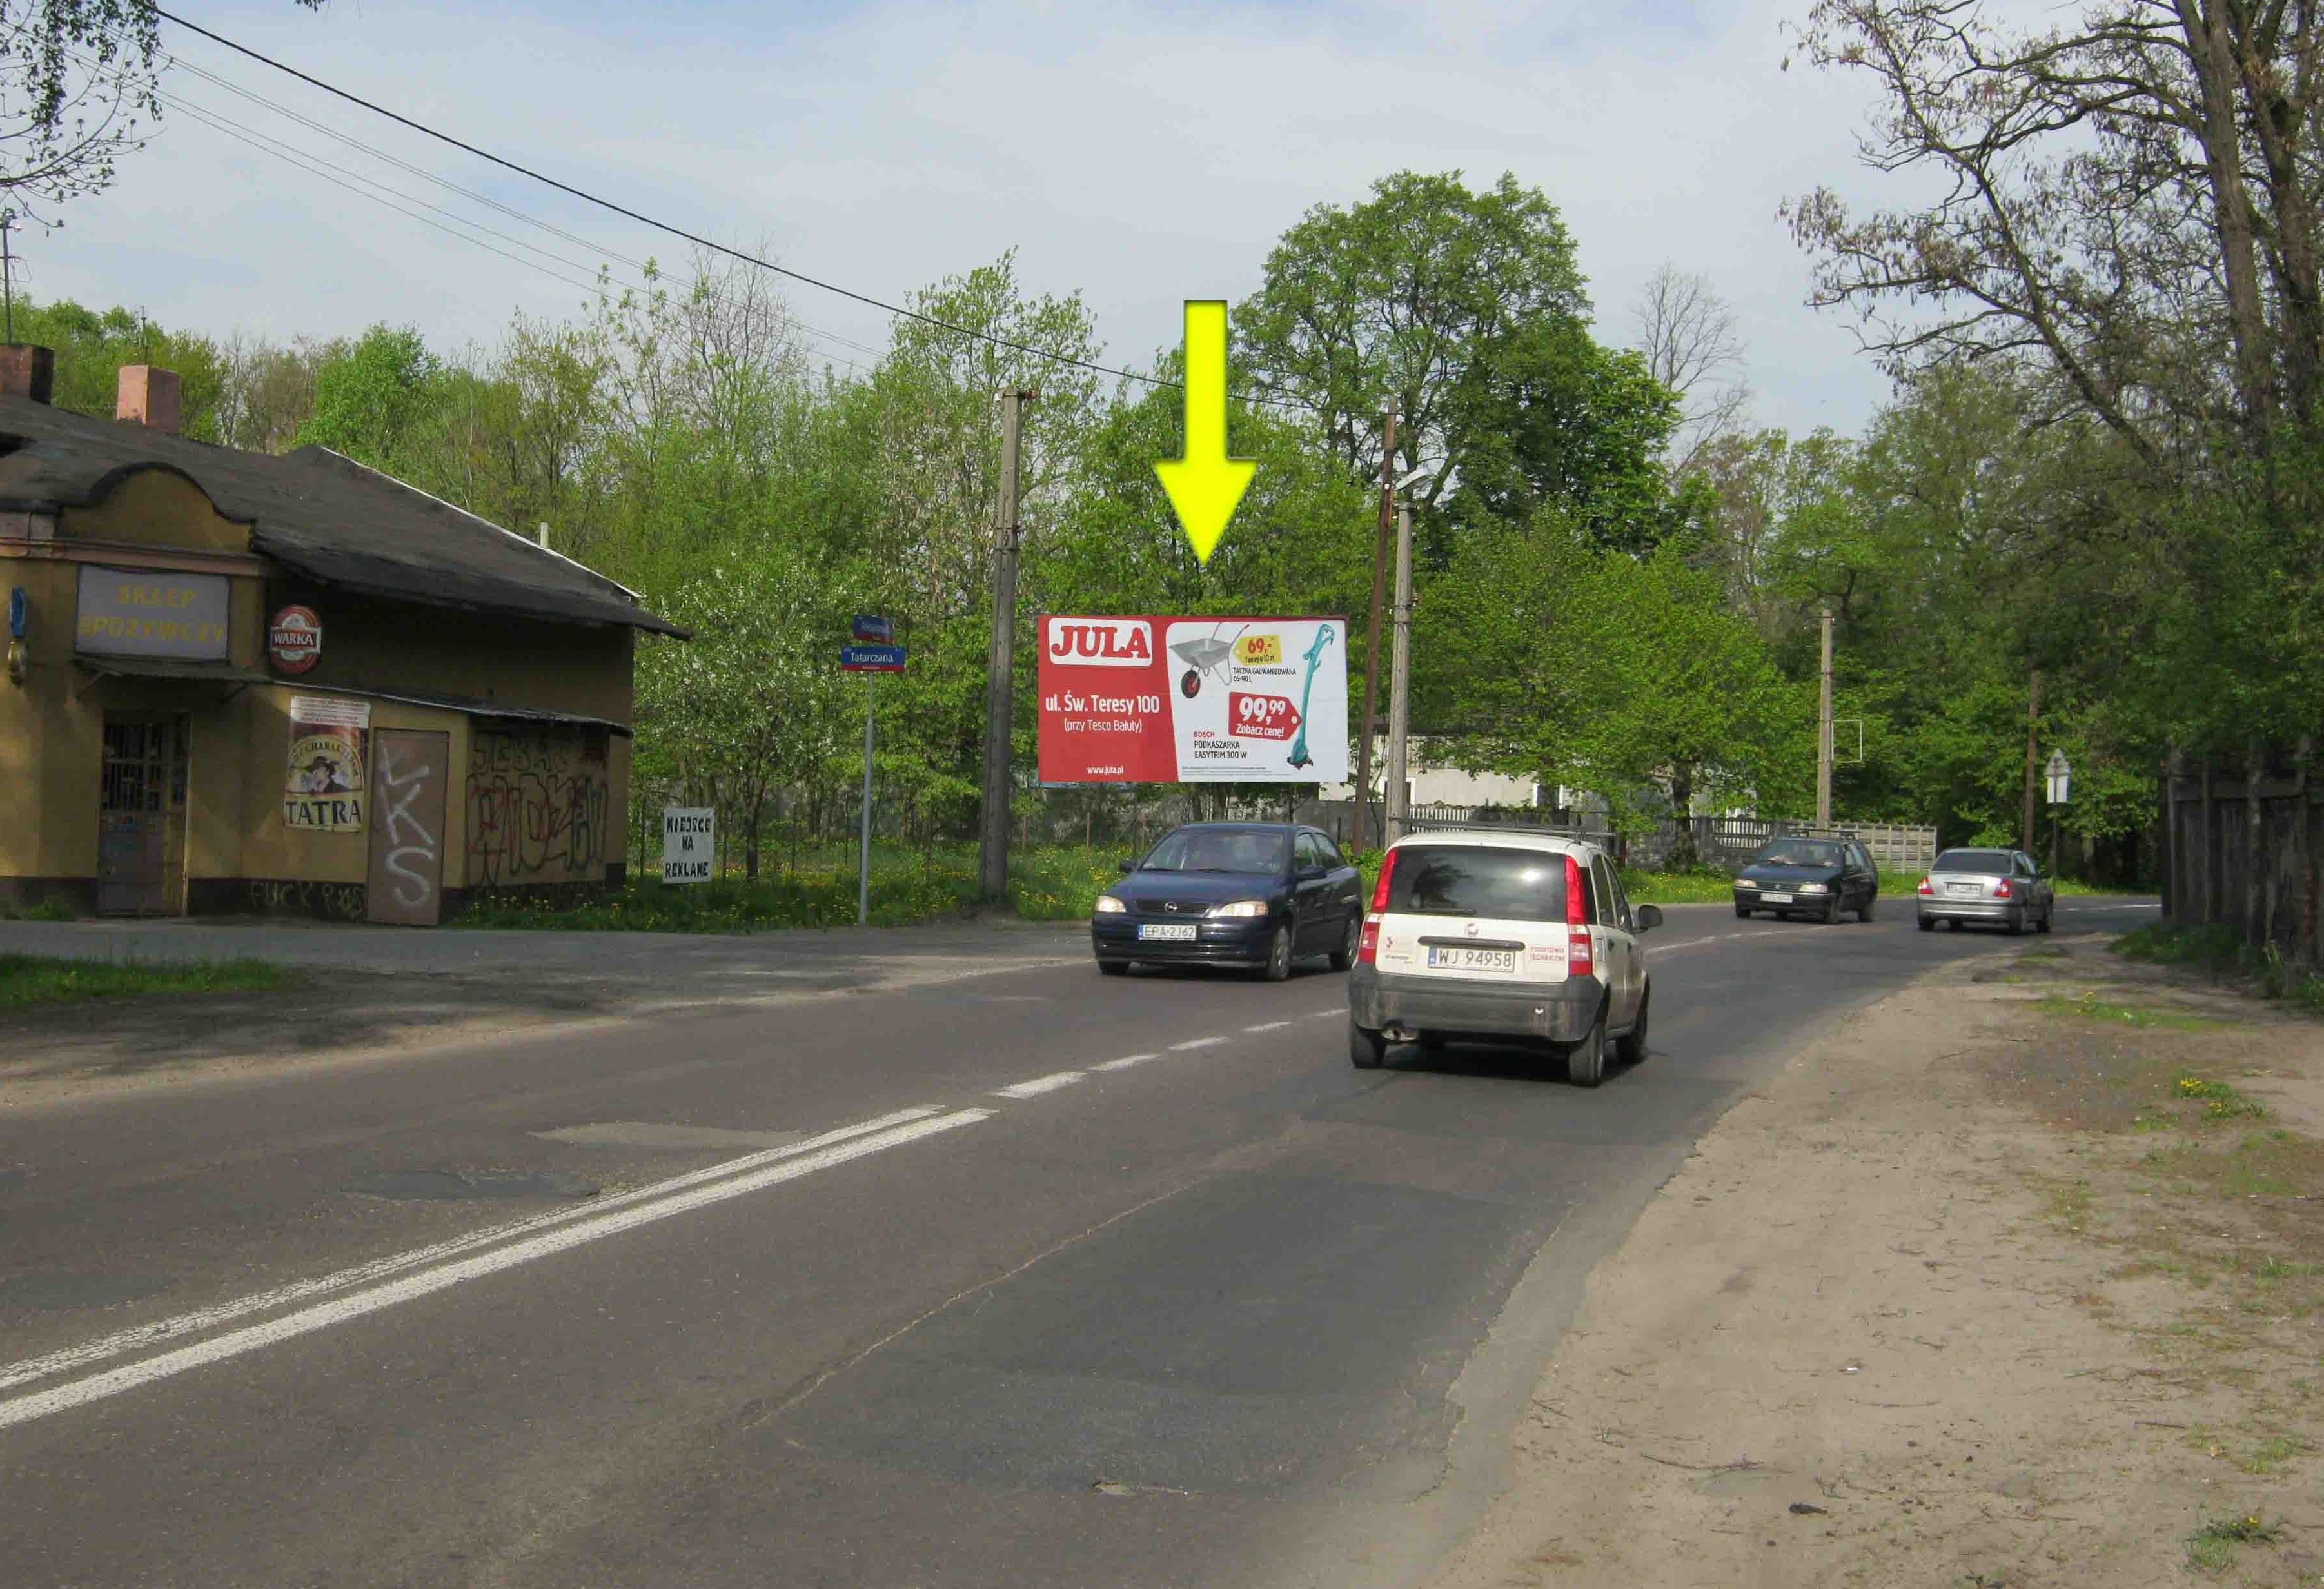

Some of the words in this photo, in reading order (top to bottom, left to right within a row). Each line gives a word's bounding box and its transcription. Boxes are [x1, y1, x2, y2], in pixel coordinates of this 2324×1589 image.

[116, 584, 197, 609] SKLEP
[274, 633, 314, 646] WARKA
[1051, 626, 1150, 658] JULA
[851, 652, 894, 662] Tatarczana
[1252, 667, 1296, 676] GALWANIZOWANA
[1045, 694, 1061, 712] ul.
[1064, 690, 1088, 712] Św.
[1091, 695, 1134, 715] Teresy
[1137, 695, 1160, 713] 100
[1064, 718, 1085, 733] (przy
[1087, 719, 1111, 731] Tesco
[1114, 718, 1143, 733] Bałuty)
[1236, 724, 1263, 735] Zobacz
[1264, 725, 1285, 738] cenę!
[1194, 740, 1240, 749] PODKASZARKA
[1194, 751, 1226, 759] EASYTRIM
[1226, 751, 1239, 759] 300
[1240, 751, 1247, 759] W
[1087, 765, 1123, 775] www.jula.pl
[286, 799, 361, 825] TATRA
[667, 816, 711, 833] MIEJSCE
[682, 835, 694, 851] NA
[1145, 925, 1167, 936] EPA
[1168, 926, 1195, 937] 2J62
[1439, 950, 1459, 963] WJ
[1466, 951, 1512, 967] 94958
